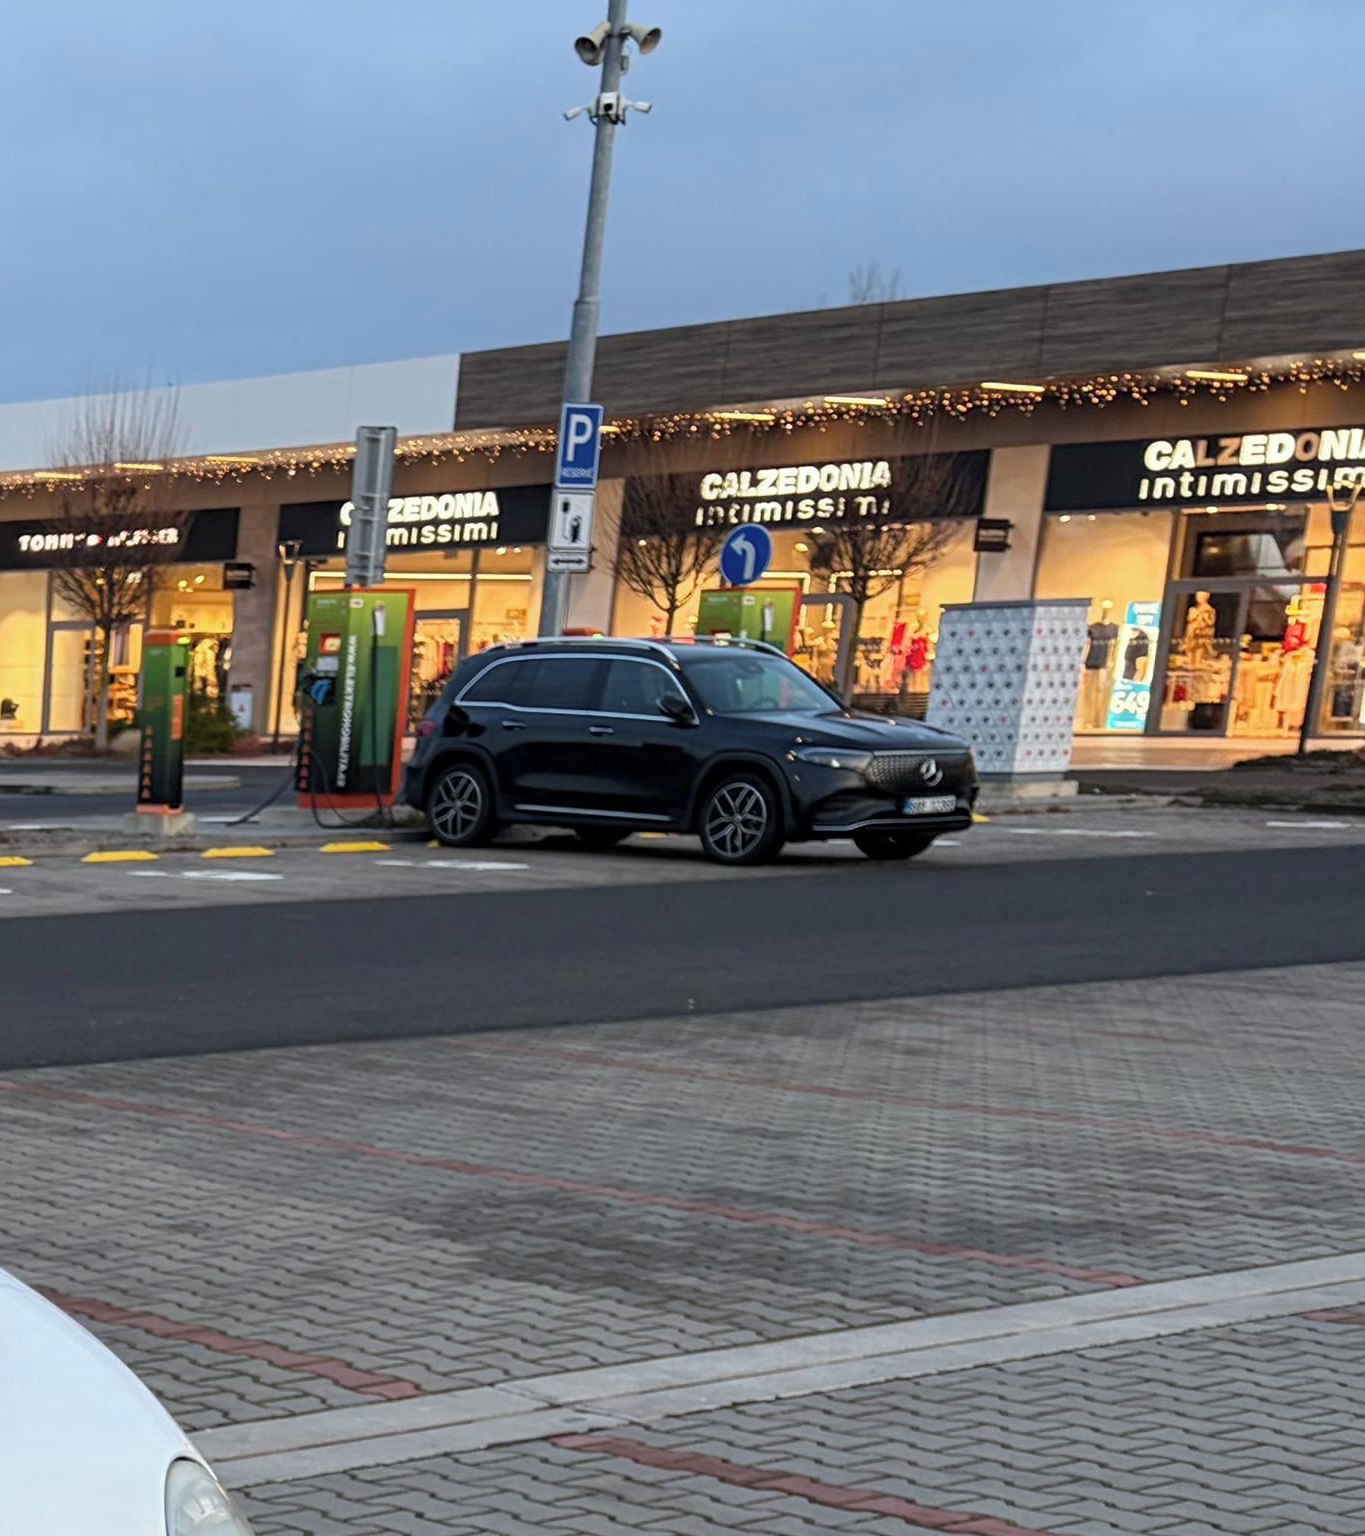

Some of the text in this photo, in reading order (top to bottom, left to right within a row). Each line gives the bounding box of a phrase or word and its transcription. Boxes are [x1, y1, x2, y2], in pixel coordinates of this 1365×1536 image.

[566, 413, 593, 462] P
[1144, 428, 1365, 471] CALZEDONI
[700, 461, 892, 500] CALZEDONIA
[340, 491, 499, 526] CZEDONIA
[337, 522, 498, 549] imissimi
